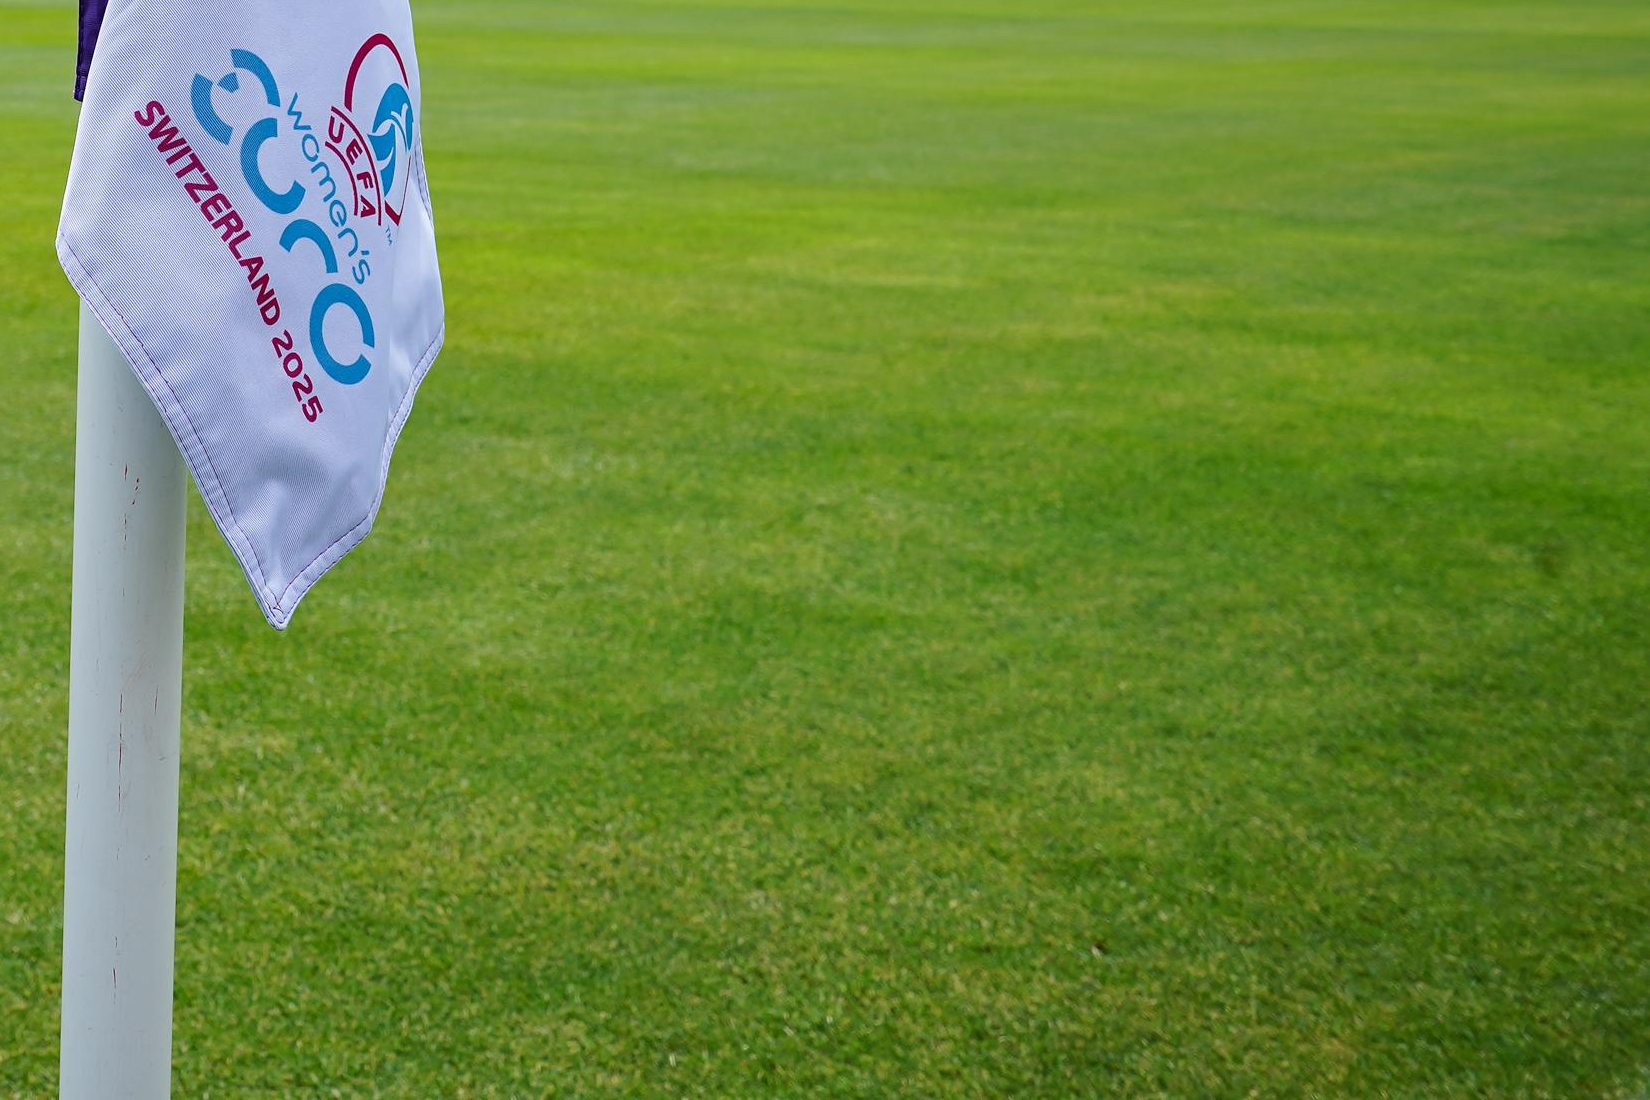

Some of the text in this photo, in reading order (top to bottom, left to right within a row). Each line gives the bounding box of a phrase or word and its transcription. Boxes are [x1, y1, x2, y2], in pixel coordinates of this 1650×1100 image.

[134, 100, 324, 423] SWITZERLAND 2025
[190, 48, 375, 386] euro
[287, 92, 371, 285] women's
[327, 115, 376, 218] UEFA
